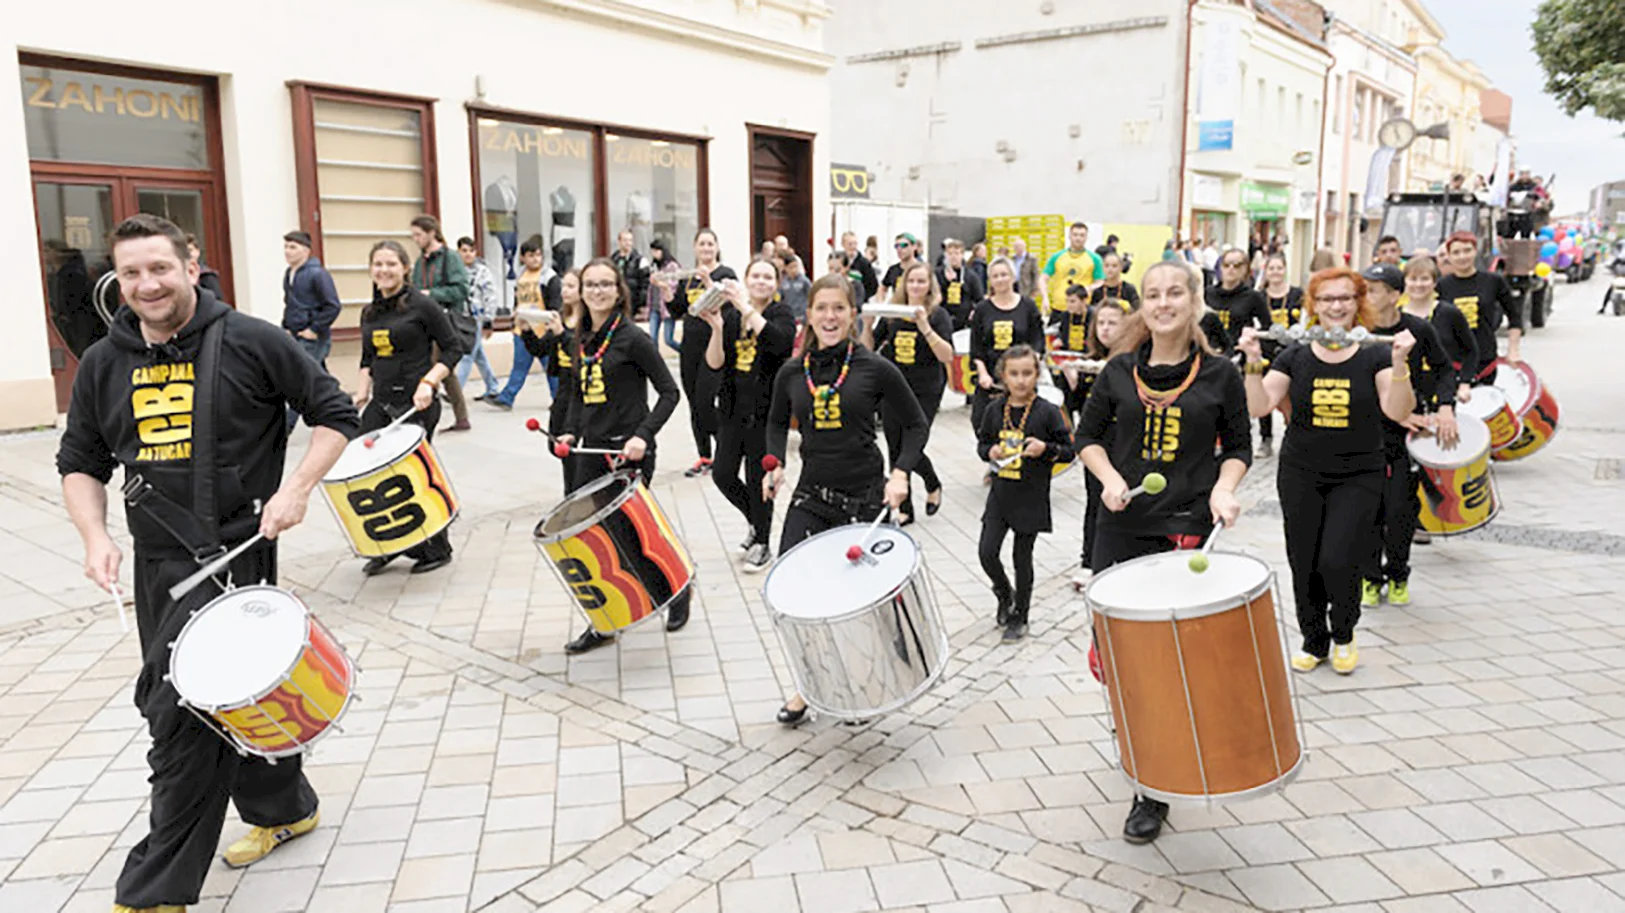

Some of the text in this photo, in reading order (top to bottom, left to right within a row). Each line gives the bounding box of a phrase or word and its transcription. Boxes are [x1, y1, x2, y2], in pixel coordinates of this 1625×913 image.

[26, 76, 200, 122] ZAHONI
[484, 127, 586, 160] ZAHONI
[613, 144, 693, 169] ZAHONI
